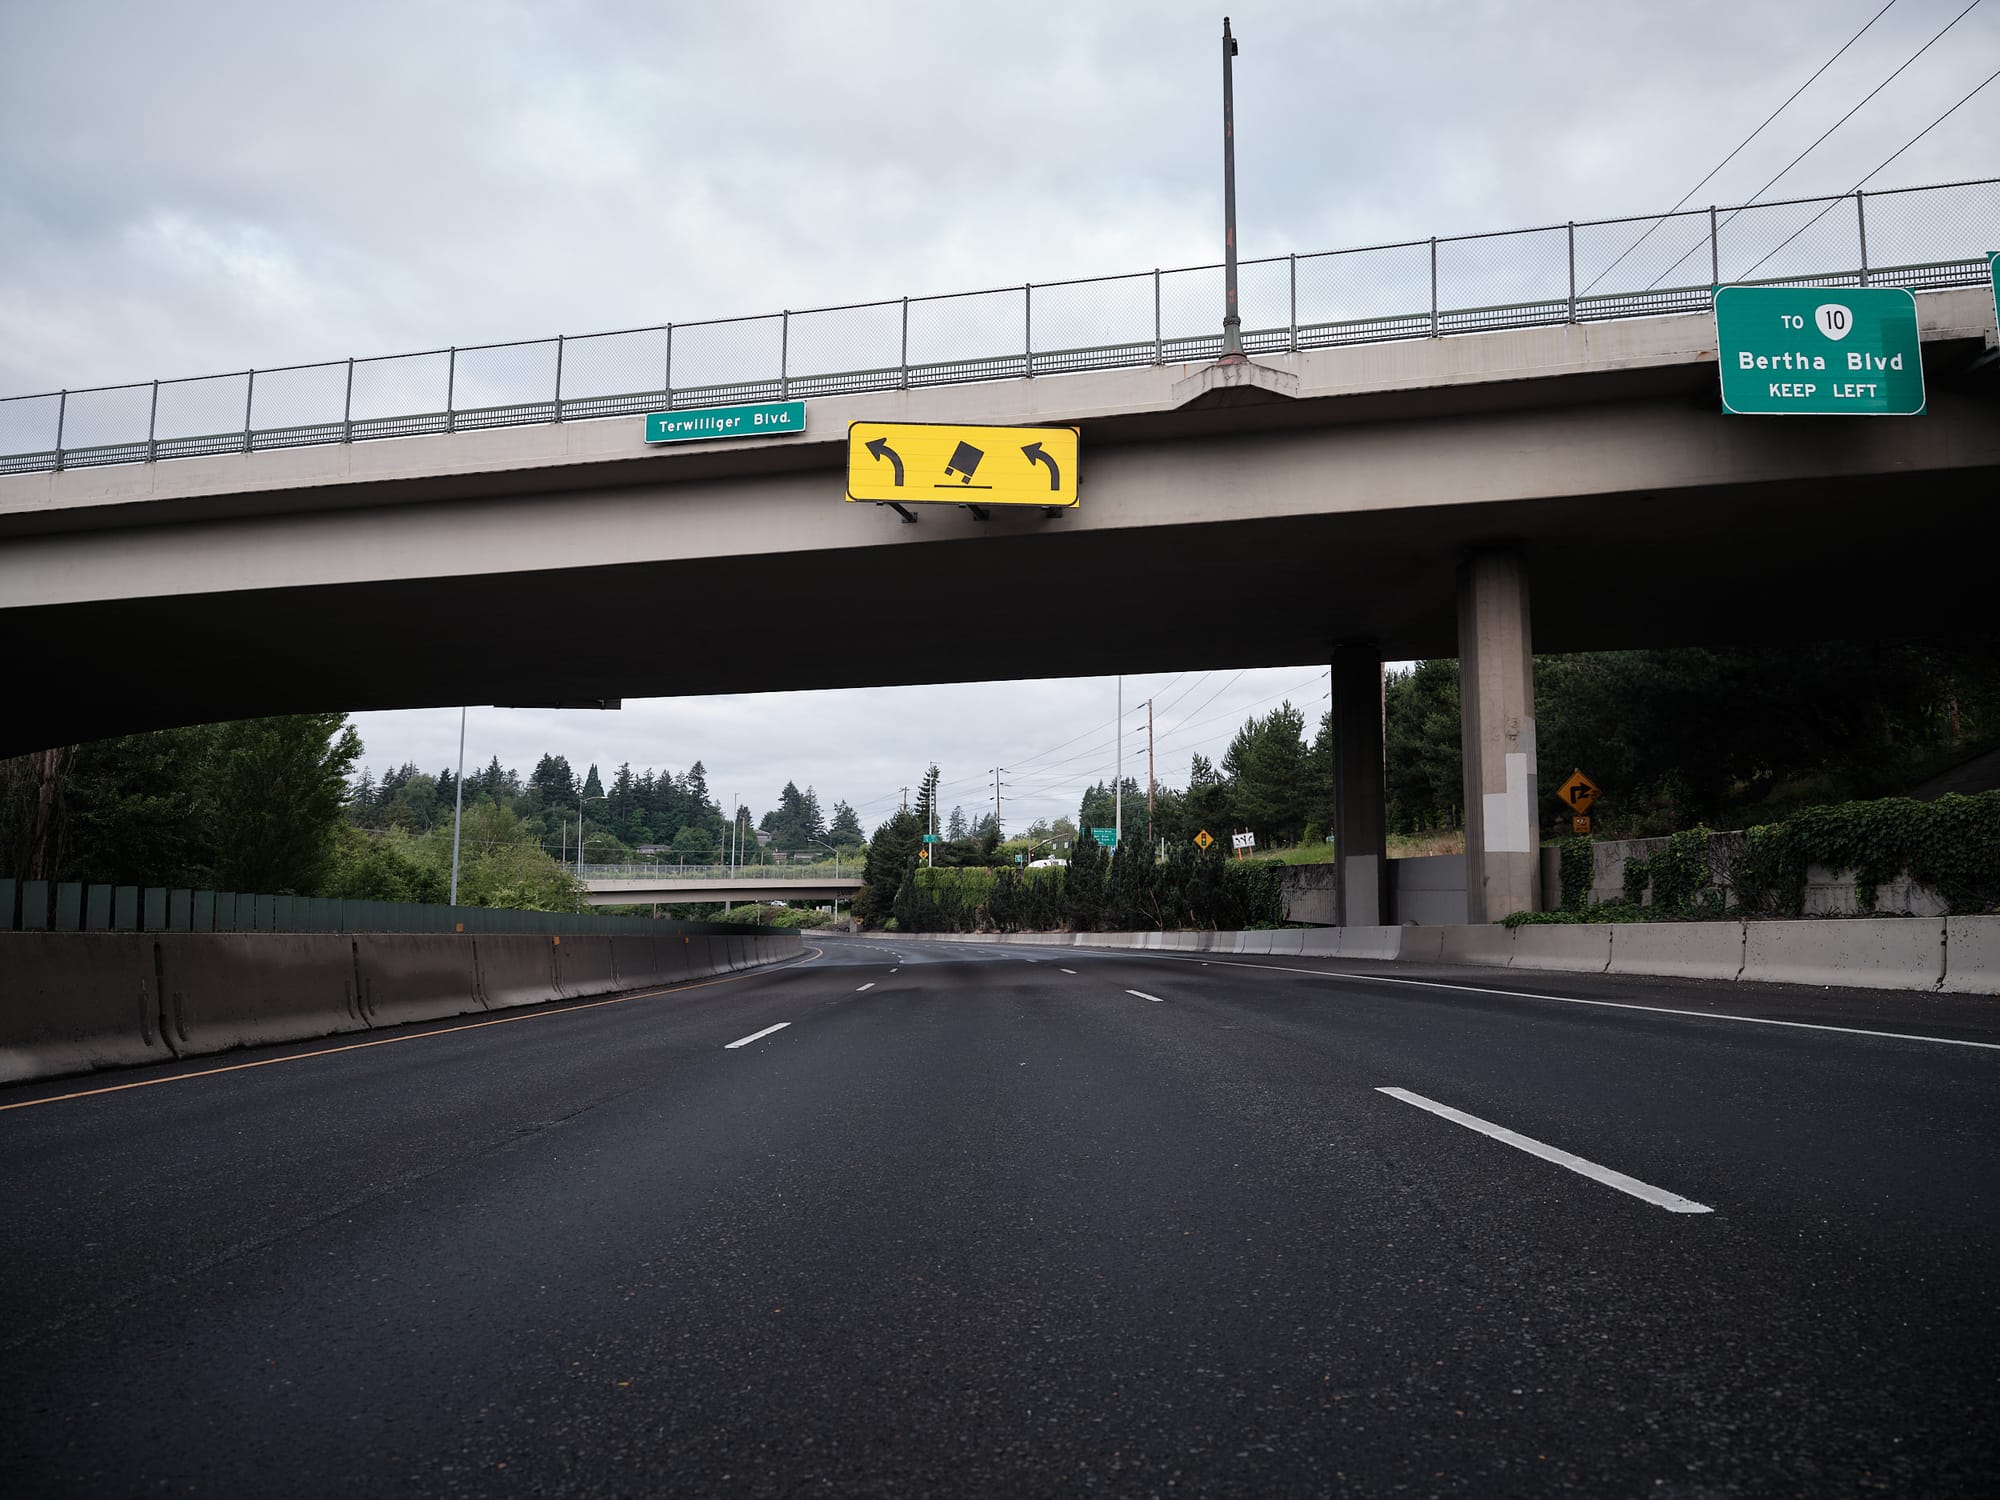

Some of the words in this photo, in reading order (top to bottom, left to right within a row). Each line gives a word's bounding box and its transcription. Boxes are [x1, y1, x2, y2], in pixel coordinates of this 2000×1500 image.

[1781, 315, 1804, 329] TO
[1826, 310, 1845, 330] 10
[1739, 351, 1826, 370] Bertha
[1847, 352, 1903, 371] Blvd
[1769, 383, 1817, 398] KEEP
[1833, 383, 1878, 398] LEFT
[659, 416, 741, 433] Terwilliger
[754, 411, 791, 425] Blvd.
